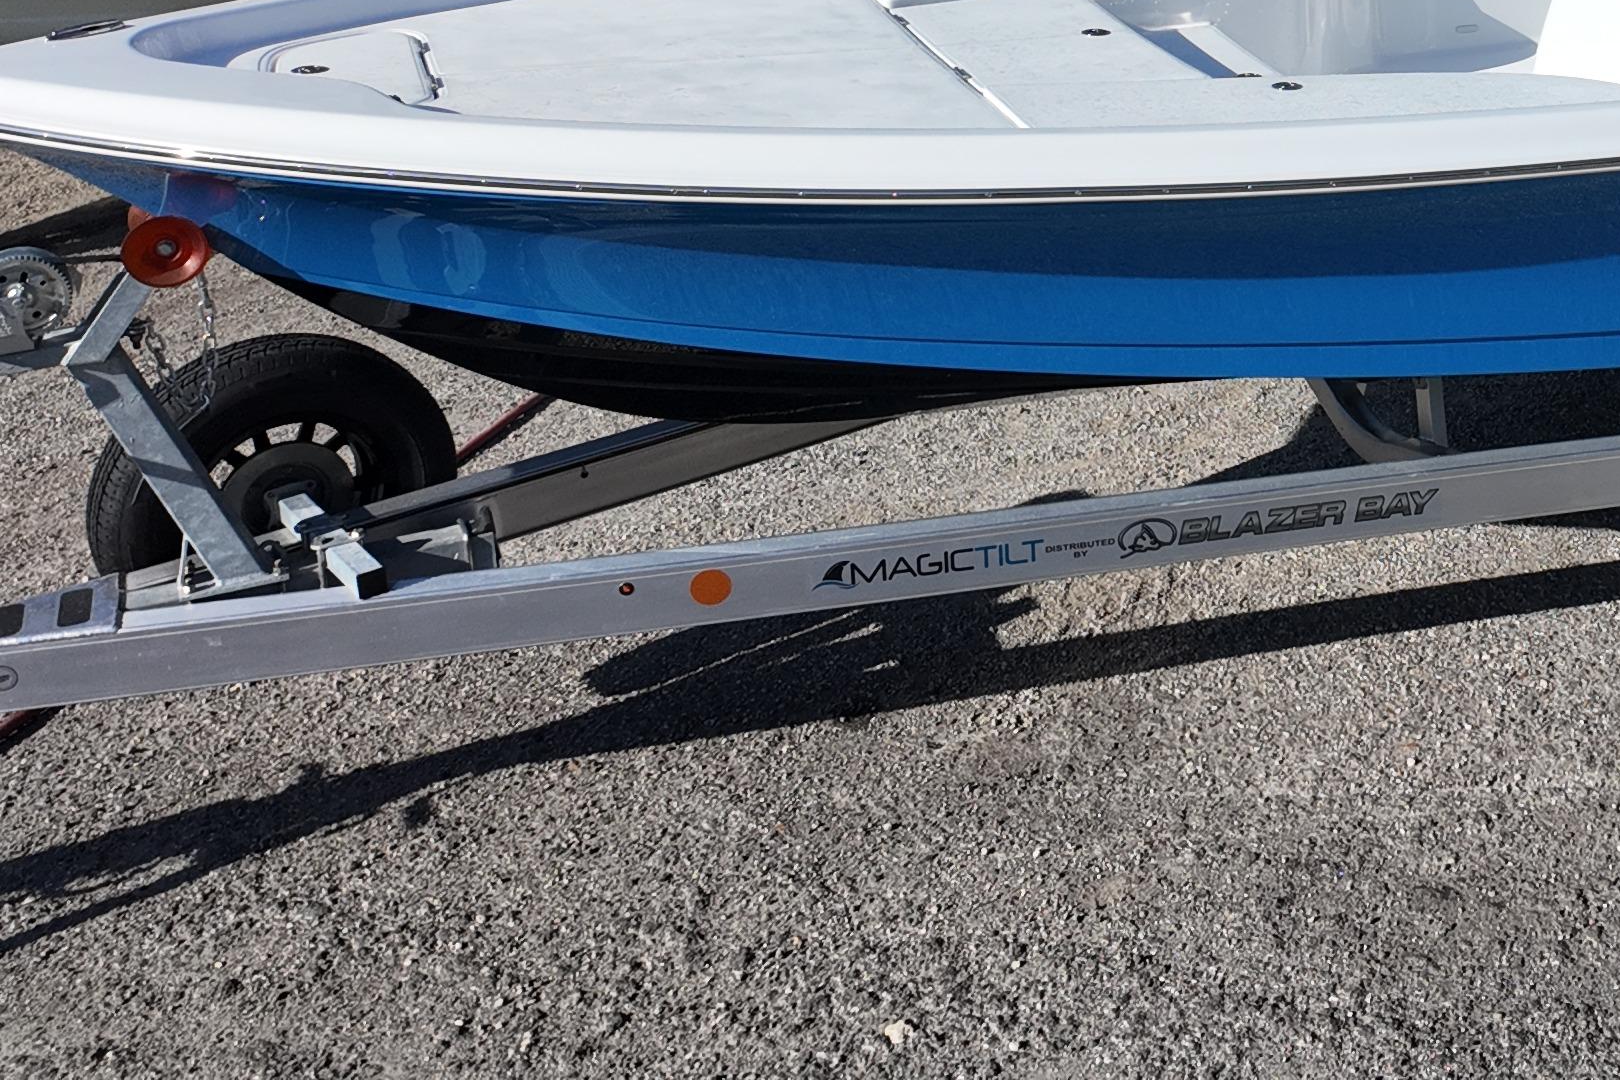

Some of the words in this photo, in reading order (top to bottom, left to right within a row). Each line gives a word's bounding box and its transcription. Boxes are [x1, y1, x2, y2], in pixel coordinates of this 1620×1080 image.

[1177, 499, 1347, 546] BLAZER
[1354, 488, 1440, 523] BAY
[850, 538, 1045, 586] MAGICTILT
[1045, 537, 1116, 555] DISTRIBUTED
[1073, 550, 1089, 559] BY
